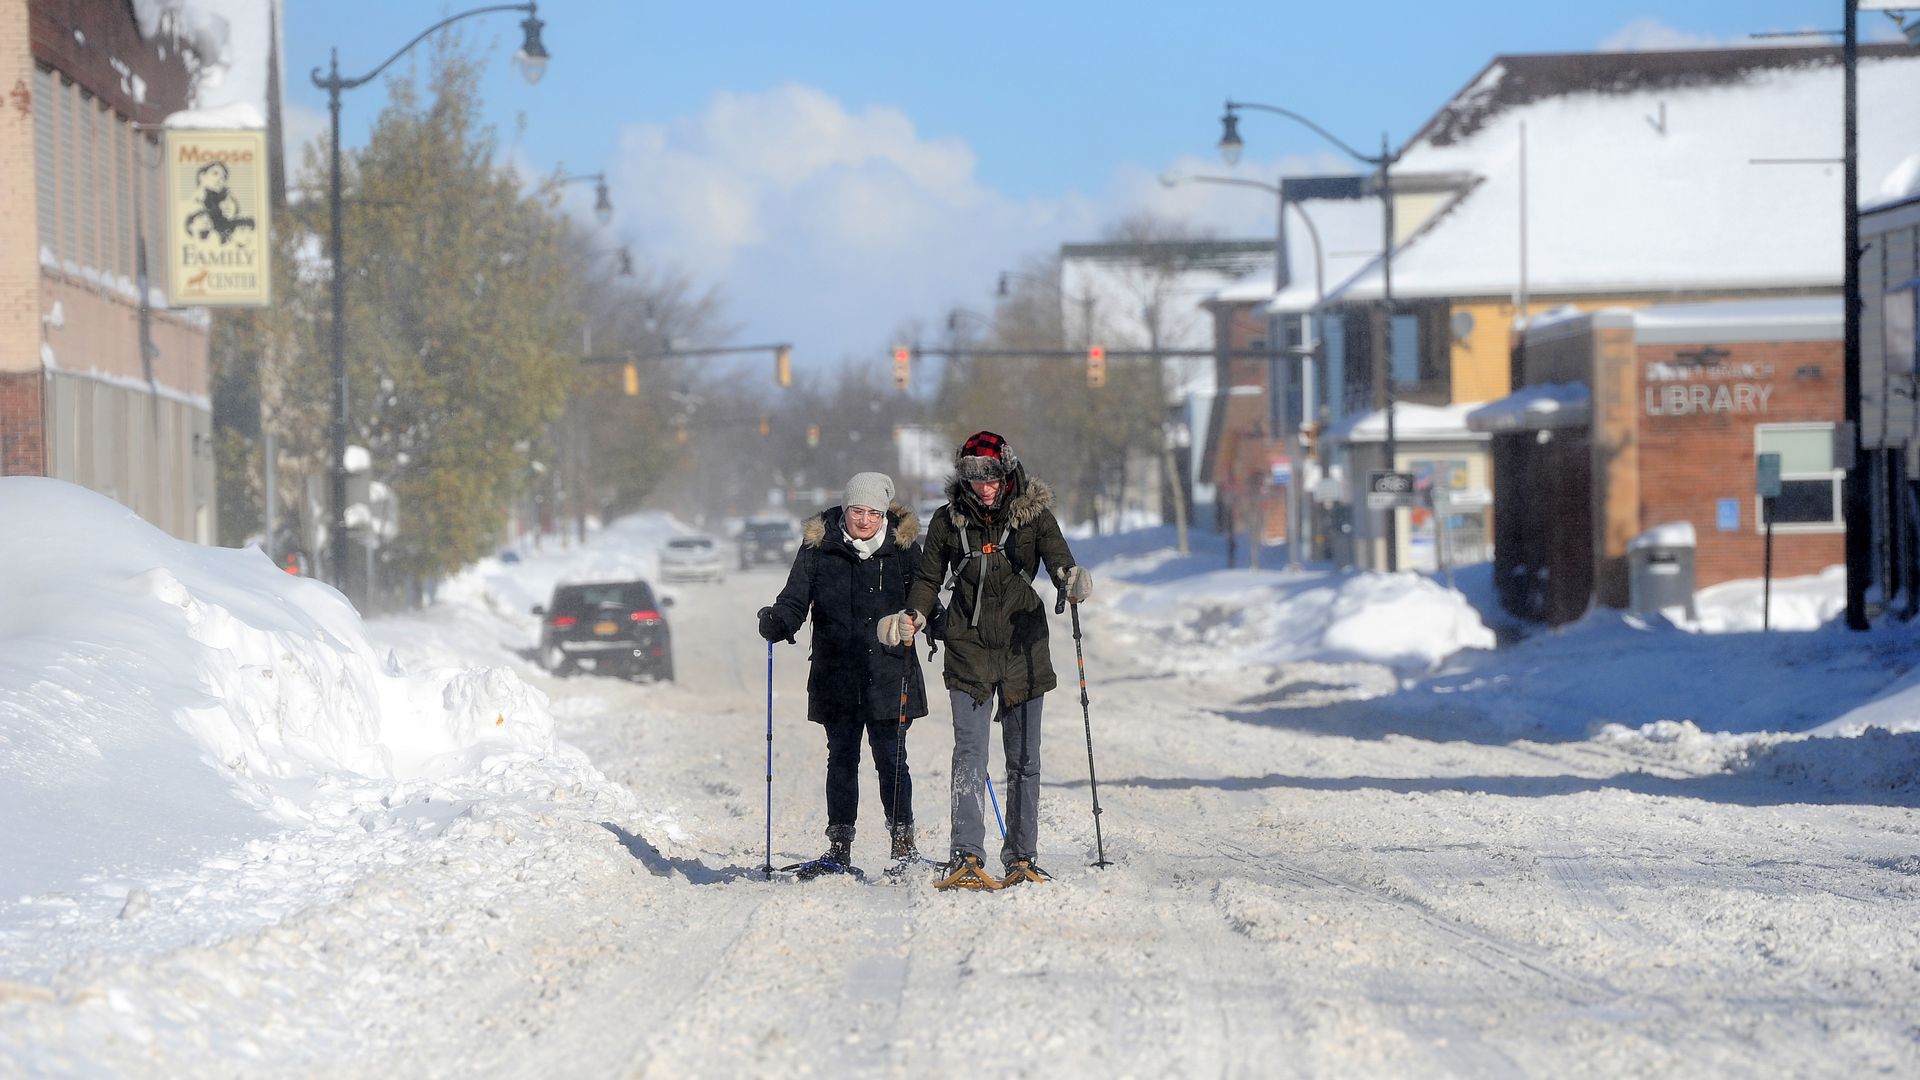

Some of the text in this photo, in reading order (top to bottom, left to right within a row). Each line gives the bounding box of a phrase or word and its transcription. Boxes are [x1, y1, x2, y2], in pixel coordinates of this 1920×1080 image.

[179, 145, 253, 163] Moose
[182, 244, 256, 266] FAMILY
[207, 272, 256, 289] CENTER
[1646, 384, 1773, 415] LIBRARY
